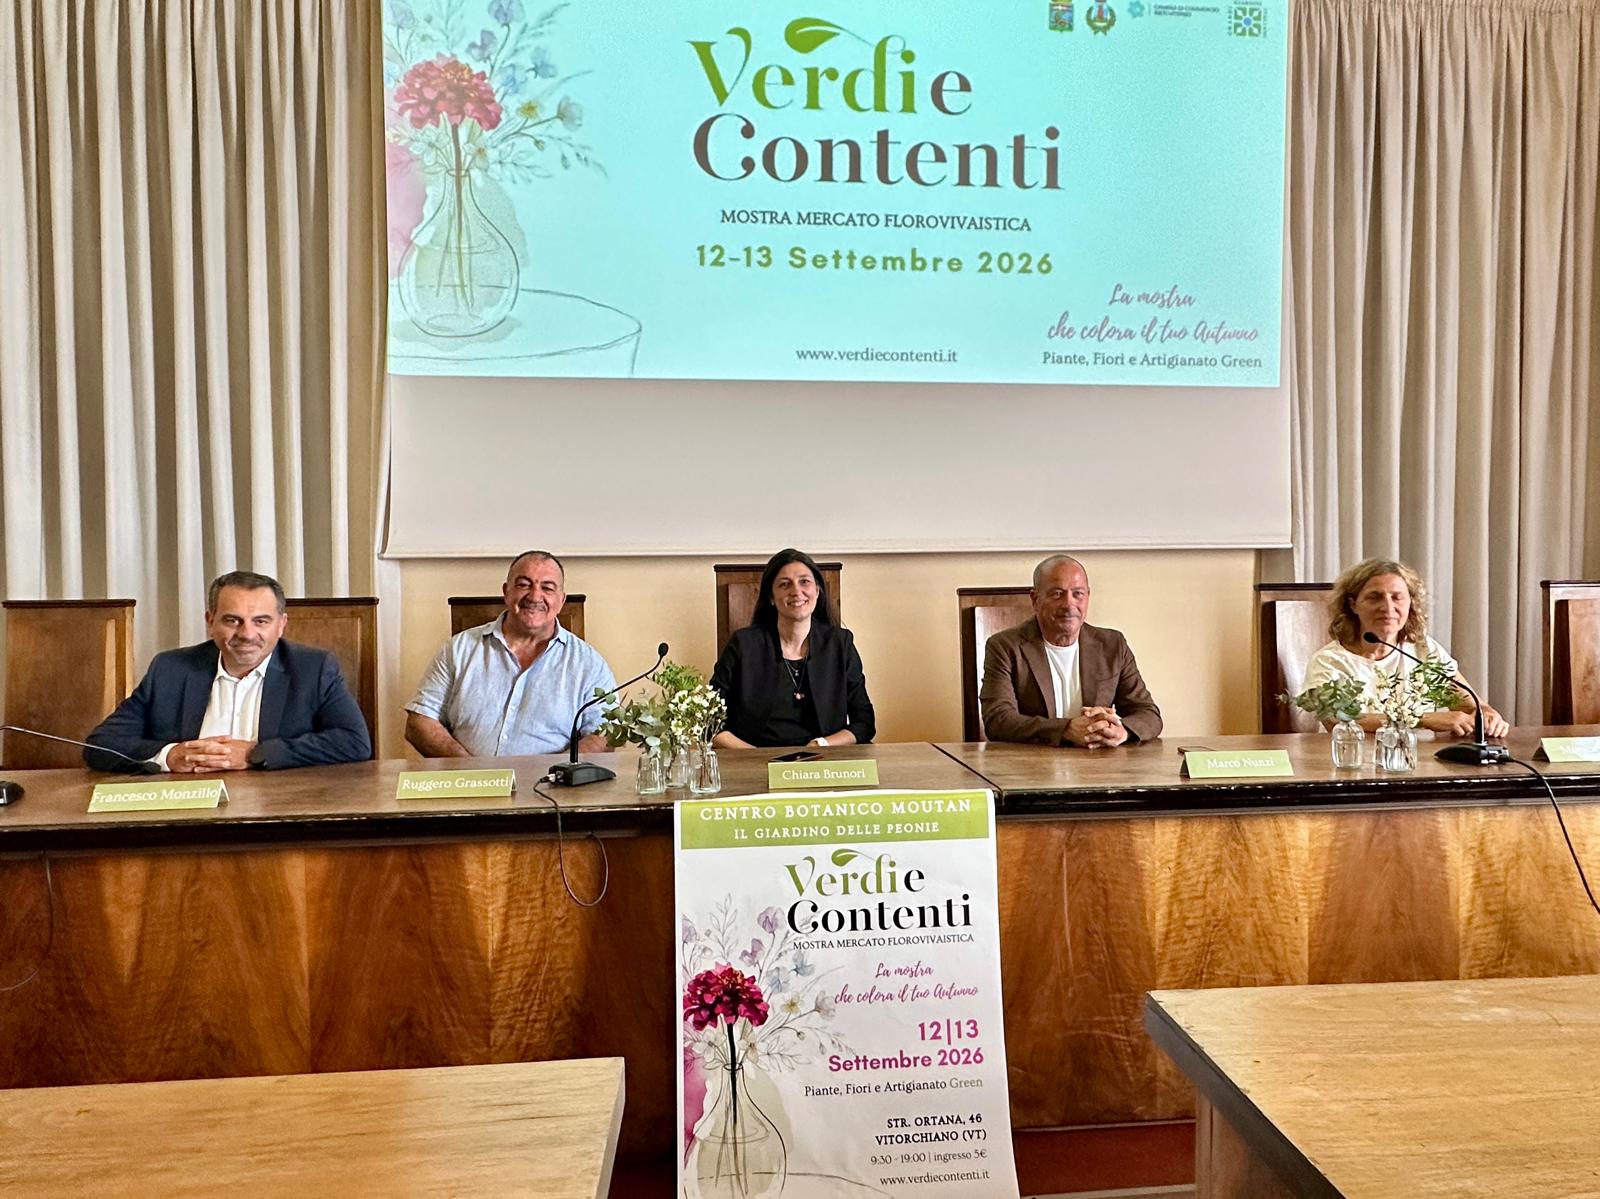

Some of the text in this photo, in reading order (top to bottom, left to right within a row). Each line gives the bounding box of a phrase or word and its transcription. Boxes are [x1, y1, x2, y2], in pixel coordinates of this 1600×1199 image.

[687, 26, 972, 115] Verdi e
[693, 113, 1065, 191] Contenti
[720, 210, 1031, 231] MOSTRA MERCATO FLOROVIVAISTICA
[696, 244, 1053, 274] 12-13 Settembre 2026
[1108, 283, 1196, 309] La mostra
[1048, 311, 1258, 344] che colora il tuo Autunno
[796, 348, 957, 363] www.verdiecontenti.it
[1043, 351, 1262, 370] Piante, Fiori e Artigianato Green
[1207, 757, 1274, 769] Marco Nunzi
[782, 768, 864, 780] Chiara Brunori
[402, 777, 509, 791] Ruggero Grassotti
[92, 788, 218, 804] Francesco Monzillo
[700, 799, 971, 820] CENTRO BOTANICO MOUTAN
[734, 822, 939, 839] IL GIARDINO DELLE PEONIE
[784, 854, 925, 896] Verdi e
[787, 894, 972, 934] Contenti
[793, 934, 974, 950] MOSTRA MERCATO FLOROVIVAISTICA
[875, 960, 934, 979] La mostra
[834, 983, 979, 1004] che colora il tuo Autunno
[828, 1047, 984, 1072] Settembre 2026
[804, 1083, 843, 1097] Piante,
[845, 1083, 872, 1094] Fiori
[884, 1080, 947, 1094] Artigianato
[949, 1078, 983, 1089] Green
[887, 1113, 982, 1129] STR. ORTANA, 46
[875, 1130, 987, 1145] VITORCHIANO (VT)
[933, 1151, 972, 1164] ingresso
[974, 1149, 987, 1159] 5€
[880, 1169, 990, 1186] www.verdiecontenti.it
